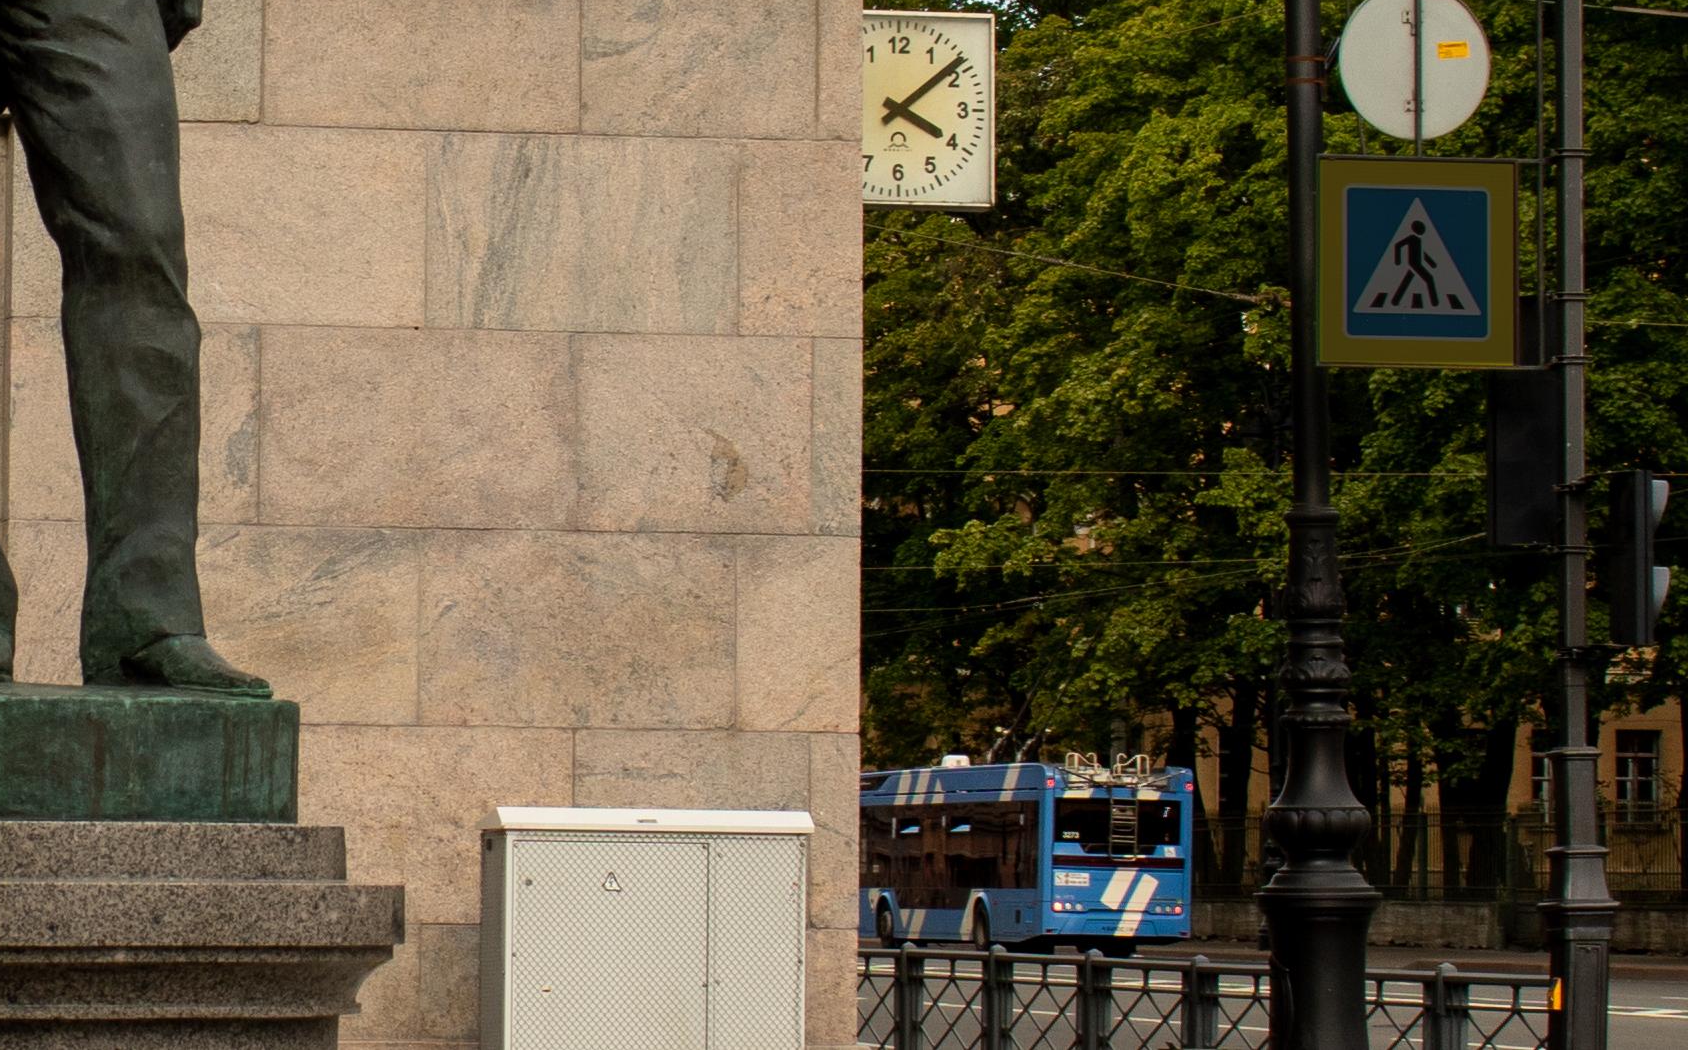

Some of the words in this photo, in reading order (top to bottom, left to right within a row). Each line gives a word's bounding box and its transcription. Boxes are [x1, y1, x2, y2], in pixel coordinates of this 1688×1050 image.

[888, 36, 910, 54] 12
[863, 45, 874, 63] 1
[926, 47, 934, 64] 1
[948, 71, 960, 88] 2
[957, 102, 969, 119] 3
[946, 133, 958, 150] 4
[862, 155, 874, 172] 7
[925, 156, 937, 173] 5
[892, 164, 904, 181] 6
